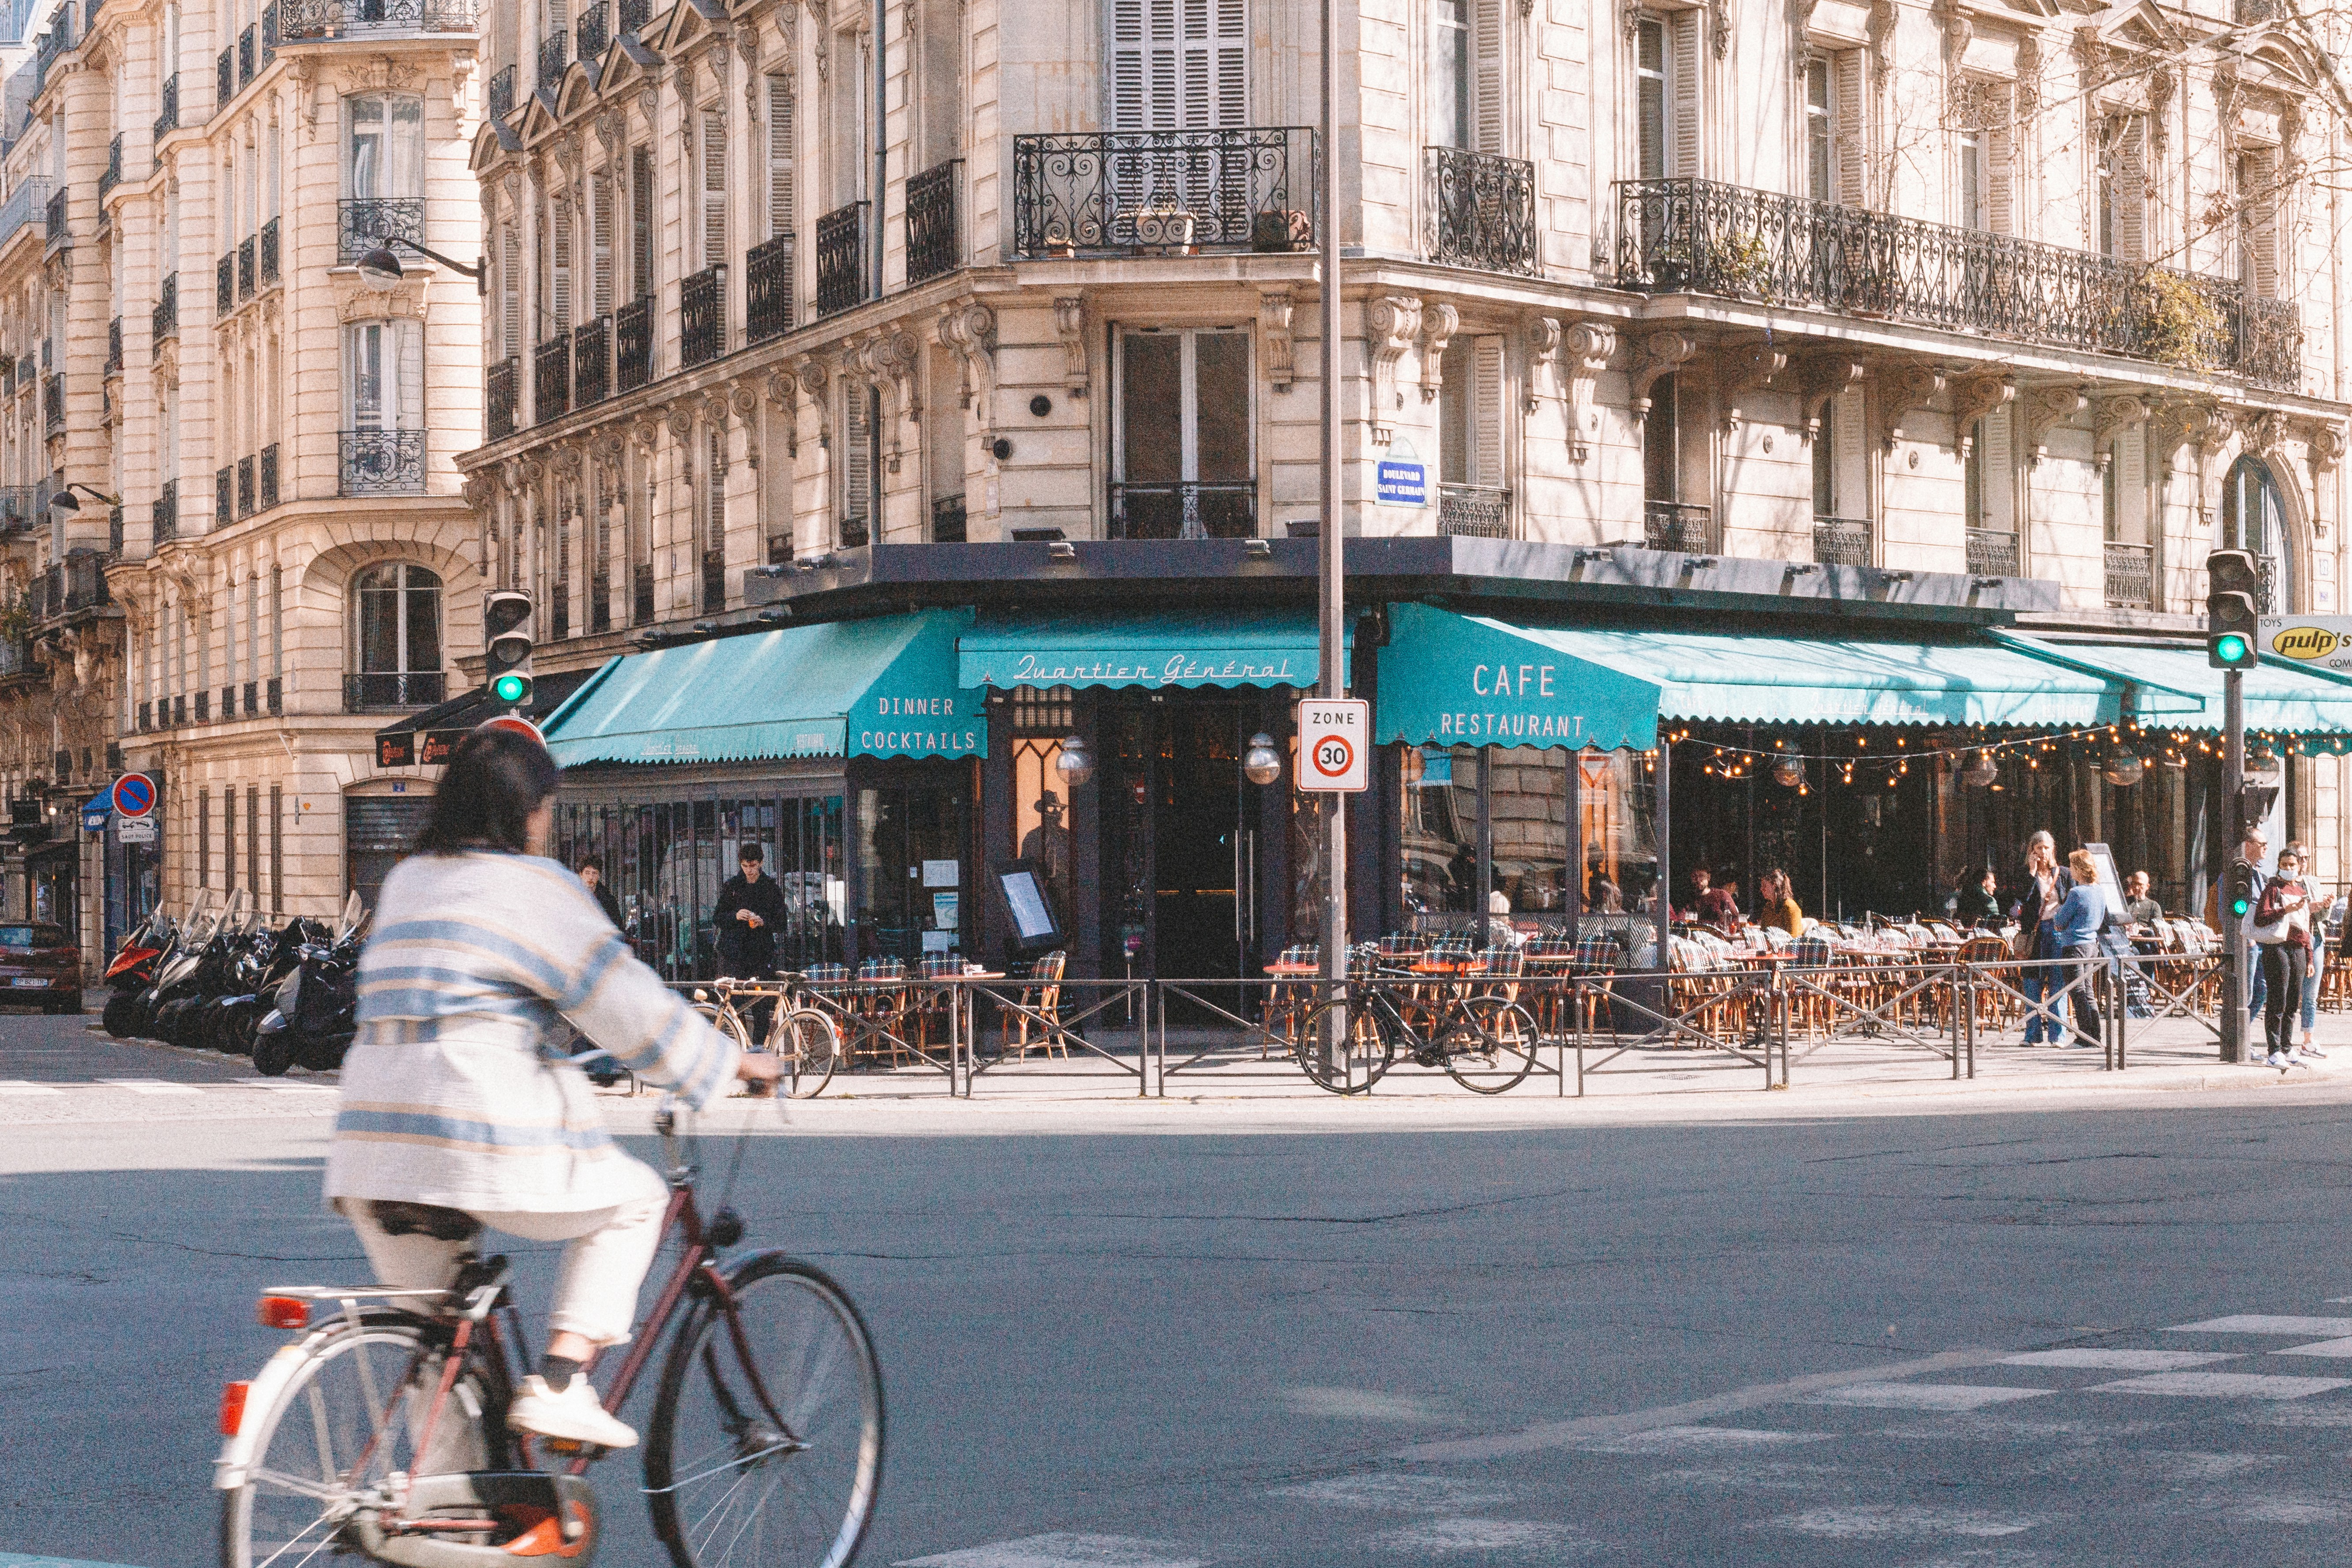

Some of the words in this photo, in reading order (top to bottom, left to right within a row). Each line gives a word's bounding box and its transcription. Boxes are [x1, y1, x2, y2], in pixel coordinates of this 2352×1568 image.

[1383, 469, 1420, 481] BOULEVARD
[1378, 484, 1396, 494] SAINT
[1397, 485, 1425, 496] GERMAIN
[2259, 619, 2282, 627] TOYS
[2281, 631, 2352, 653] pulp's
[1014, 655, 1155, 680] Quartier
[1161, 654, 1294, 684] Général
[2329, 659, 2352, 668] COM
[1474, 664, 1555, 697] CAFE
[879, 697, 954, 716] DINNER
[1313, 712, 1354, 724] ZONE
[1441, 713, 1584, 737] RESTAURANT
[861, 731, 975, 750] COCKTAILS
[1321, 747, 1346, 765] 30
